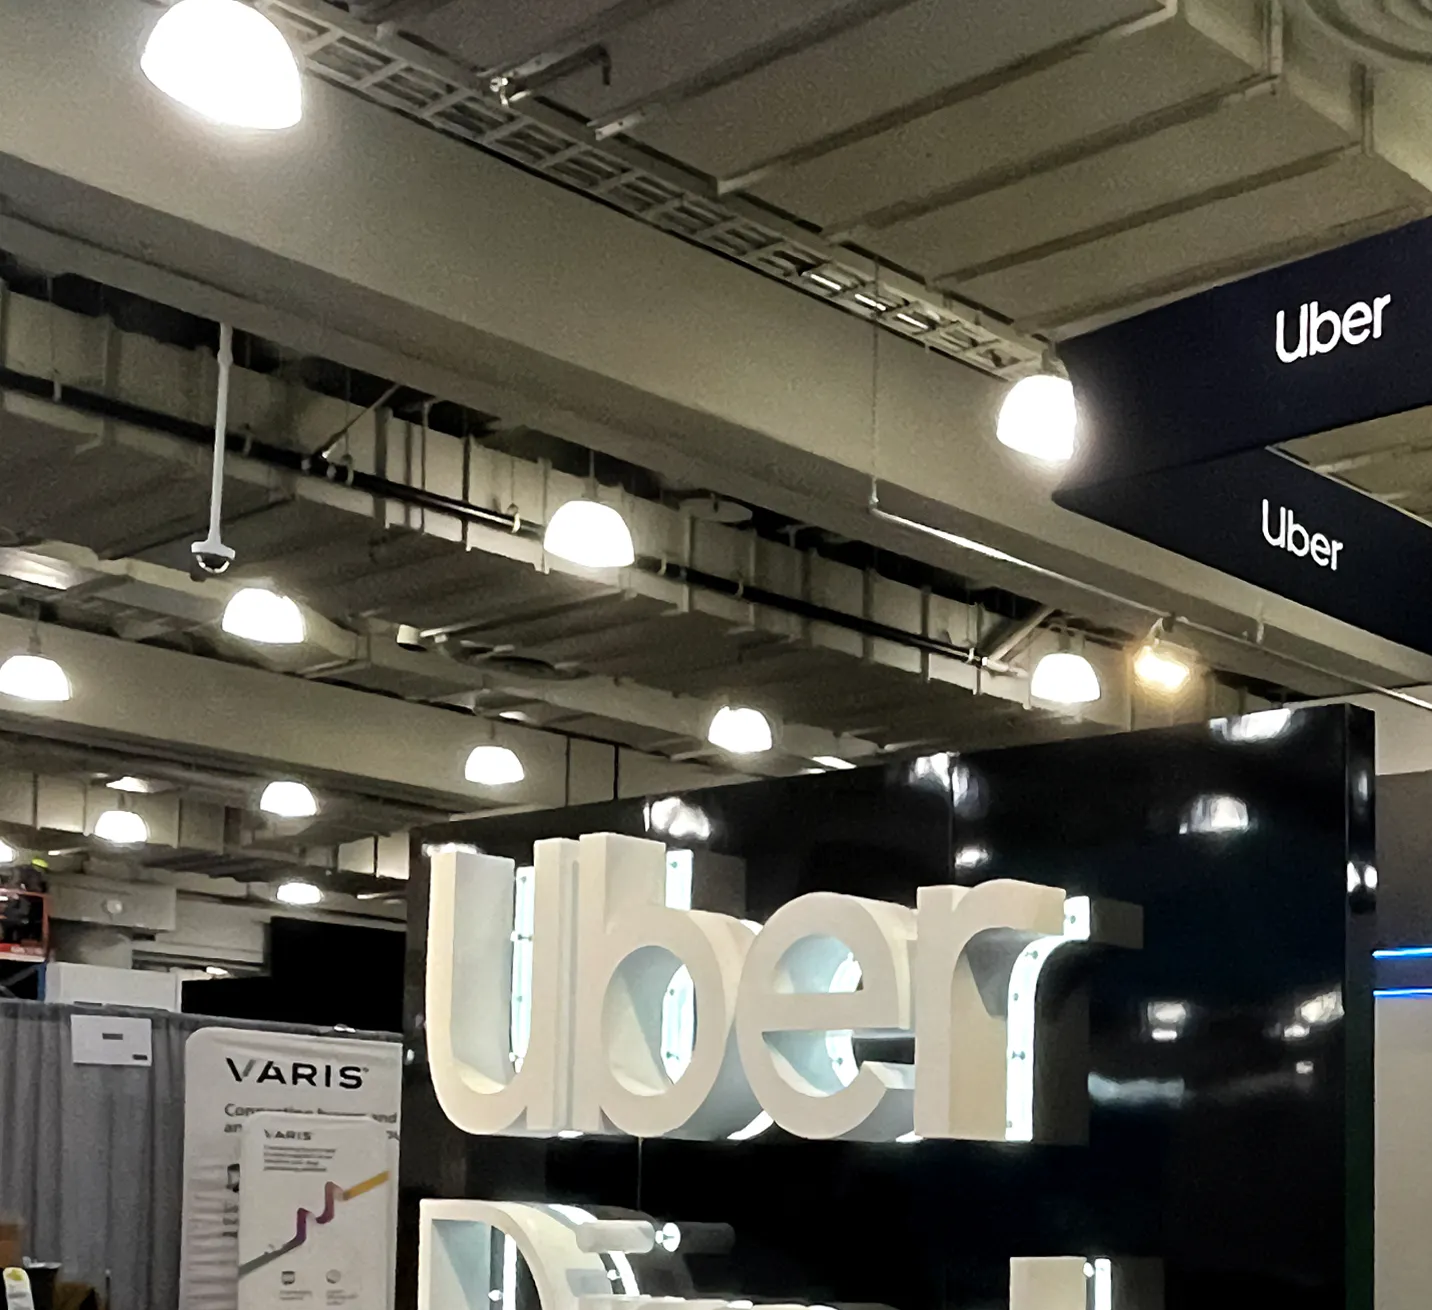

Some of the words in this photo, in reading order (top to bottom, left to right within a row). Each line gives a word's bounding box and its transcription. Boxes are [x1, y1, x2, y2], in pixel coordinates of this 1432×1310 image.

[1276, 294, 1391, 363] Uber
[1261, 498, 1343, 571] Uber
[426, 832, 1090, 1142] Uber
[226, 1058, 364, 1089] VARIS
[264, 1129, 312, 1140] VARIS
